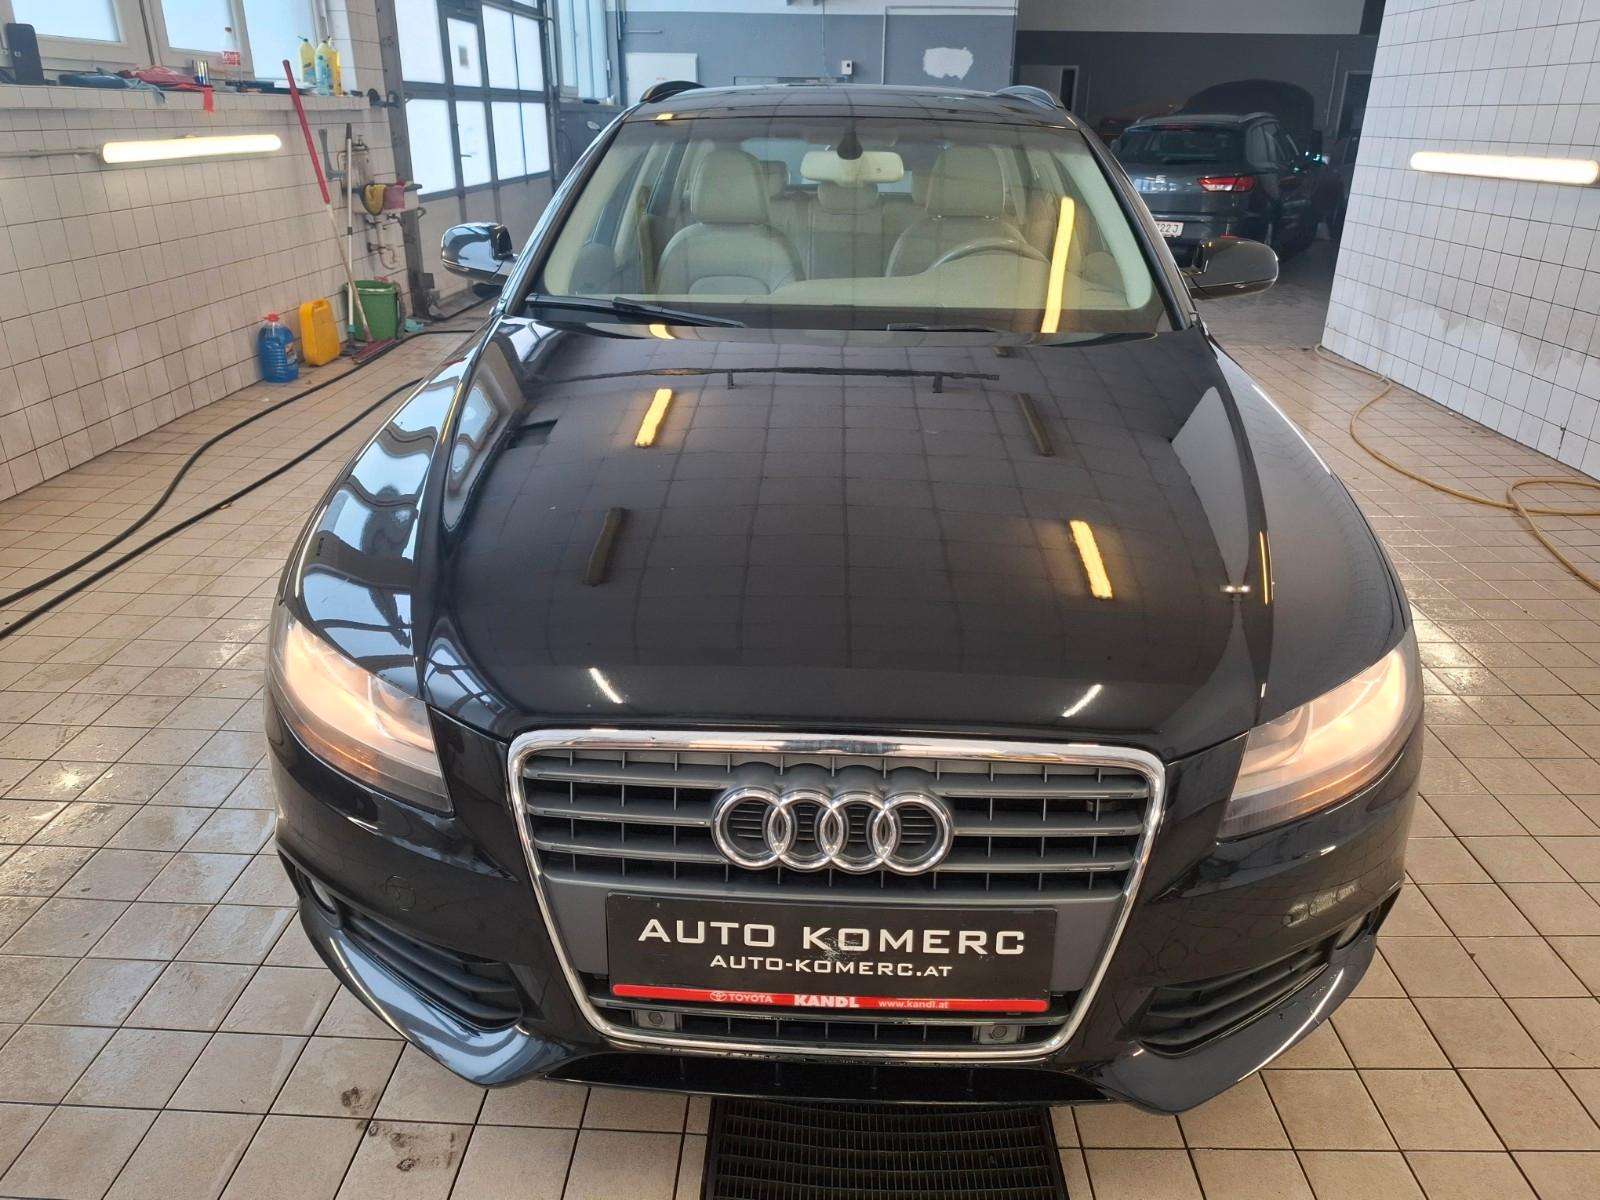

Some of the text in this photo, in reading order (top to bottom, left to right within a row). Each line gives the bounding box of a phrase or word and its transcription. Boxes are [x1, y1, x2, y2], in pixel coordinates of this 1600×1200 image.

[1156, 223, 1179, 233] 22J
[638, 918, 1025, 955] AUTO KOMERC
[709, 954, 953, 977] AUTO-KOMERC.AT
[728, 992, 949, 1010] TOYOTA KANDL www.kandl.at
